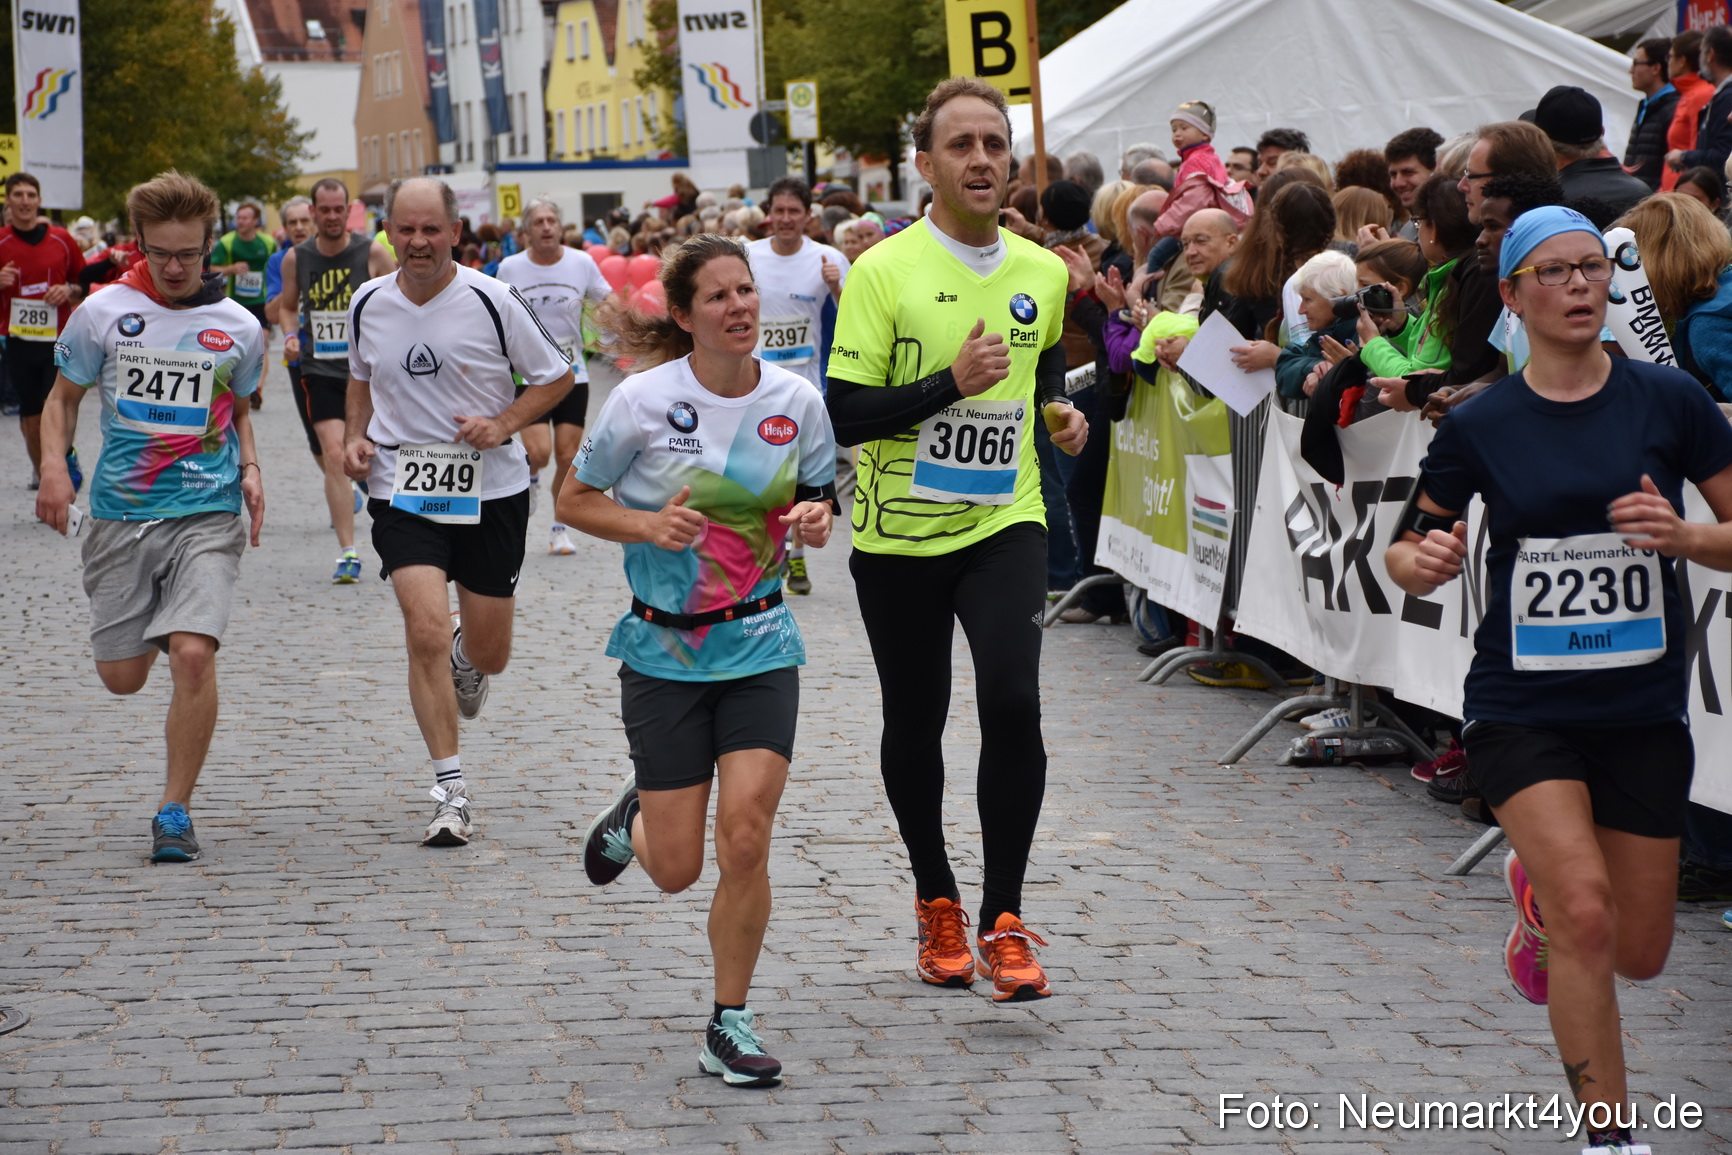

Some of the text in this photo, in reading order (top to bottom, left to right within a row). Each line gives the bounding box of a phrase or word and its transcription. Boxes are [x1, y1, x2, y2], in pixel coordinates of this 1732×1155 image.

[22, 10, 76, 34] swn
[1688, 2, 1726, 31] Heris
[970, 10, 1017, 77] B
[504, 194, 516, 211] D
[19, 309, 49, 325] 289
[316, 322, 348, 340] 217
[763, 326, 808, 347] 2397
[1010, 328, 1039, 341] Partl
[120, 353, 198, 369] PARTL Neumarkt
[837, 346, 859, 360] Partl
[411, 361, 432, 369] adidas
[126, 367, 201, 403] 2471
[148, 408, 176, 422] Heni
[939, 408, 1013, 421] RTL Neumarkt
[764, 423, 794, 438] Hervis
[669, 438, 703, 448] PARTL
[669, 446, 703, 455] Neumarkt
[929, 421, 1016, 465] 3066
[400, 449, 468, 460] PARTL Neumarkt
[403, 462, 474, 493] 2349
[420, 500, 451, 512] Josef
[1518, 546, 1637, 563] PARTL Neumarkt
[1525, 564, 1651, 618] 2230
[1568, 629, 1612, 650] Anni
